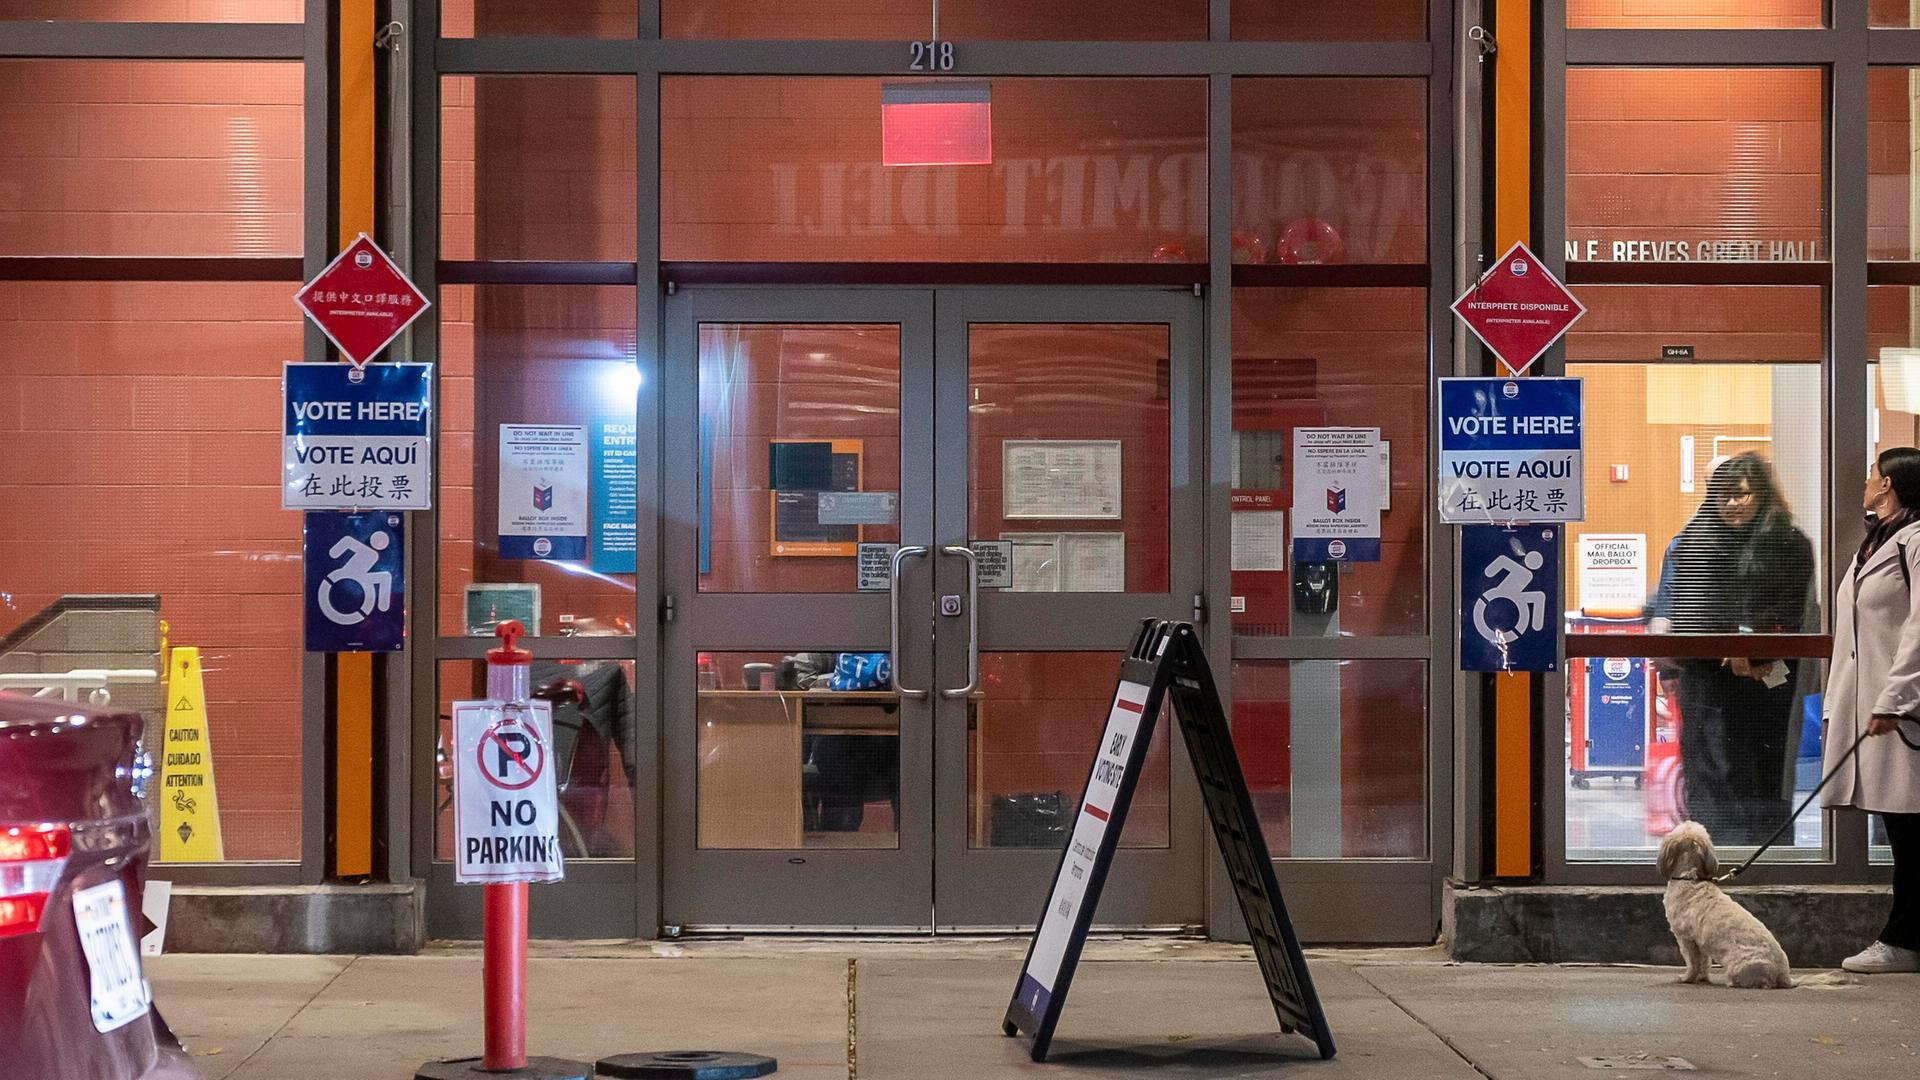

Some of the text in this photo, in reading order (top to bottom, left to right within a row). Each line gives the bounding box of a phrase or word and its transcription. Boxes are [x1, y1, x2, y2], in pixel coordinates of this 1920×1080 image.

[910, 41, 954, 70] 218
[1613, 240, 1690, 261] REEVES
[1520, 303, 1569, 311] DISPONIBLE
[292, 402, 420, 420] VOTE HERE
[1448, 416, 1574, 435] VOTE HERE
[295, 442, 417, 465] VOTE AQUÍ
[1452, 456, 1571, 479] VOTE AQUÍ
[300, 473, 413, 500] 在此投票
[1457, 488, 1568, 514] 在此投票
[169, 728, 199, 741] CAUTION
[167, 752, 201, 766] CUIDADO
[165, 774, 204, 787] ATTENTION
[491, 800, 536, 826] NO
